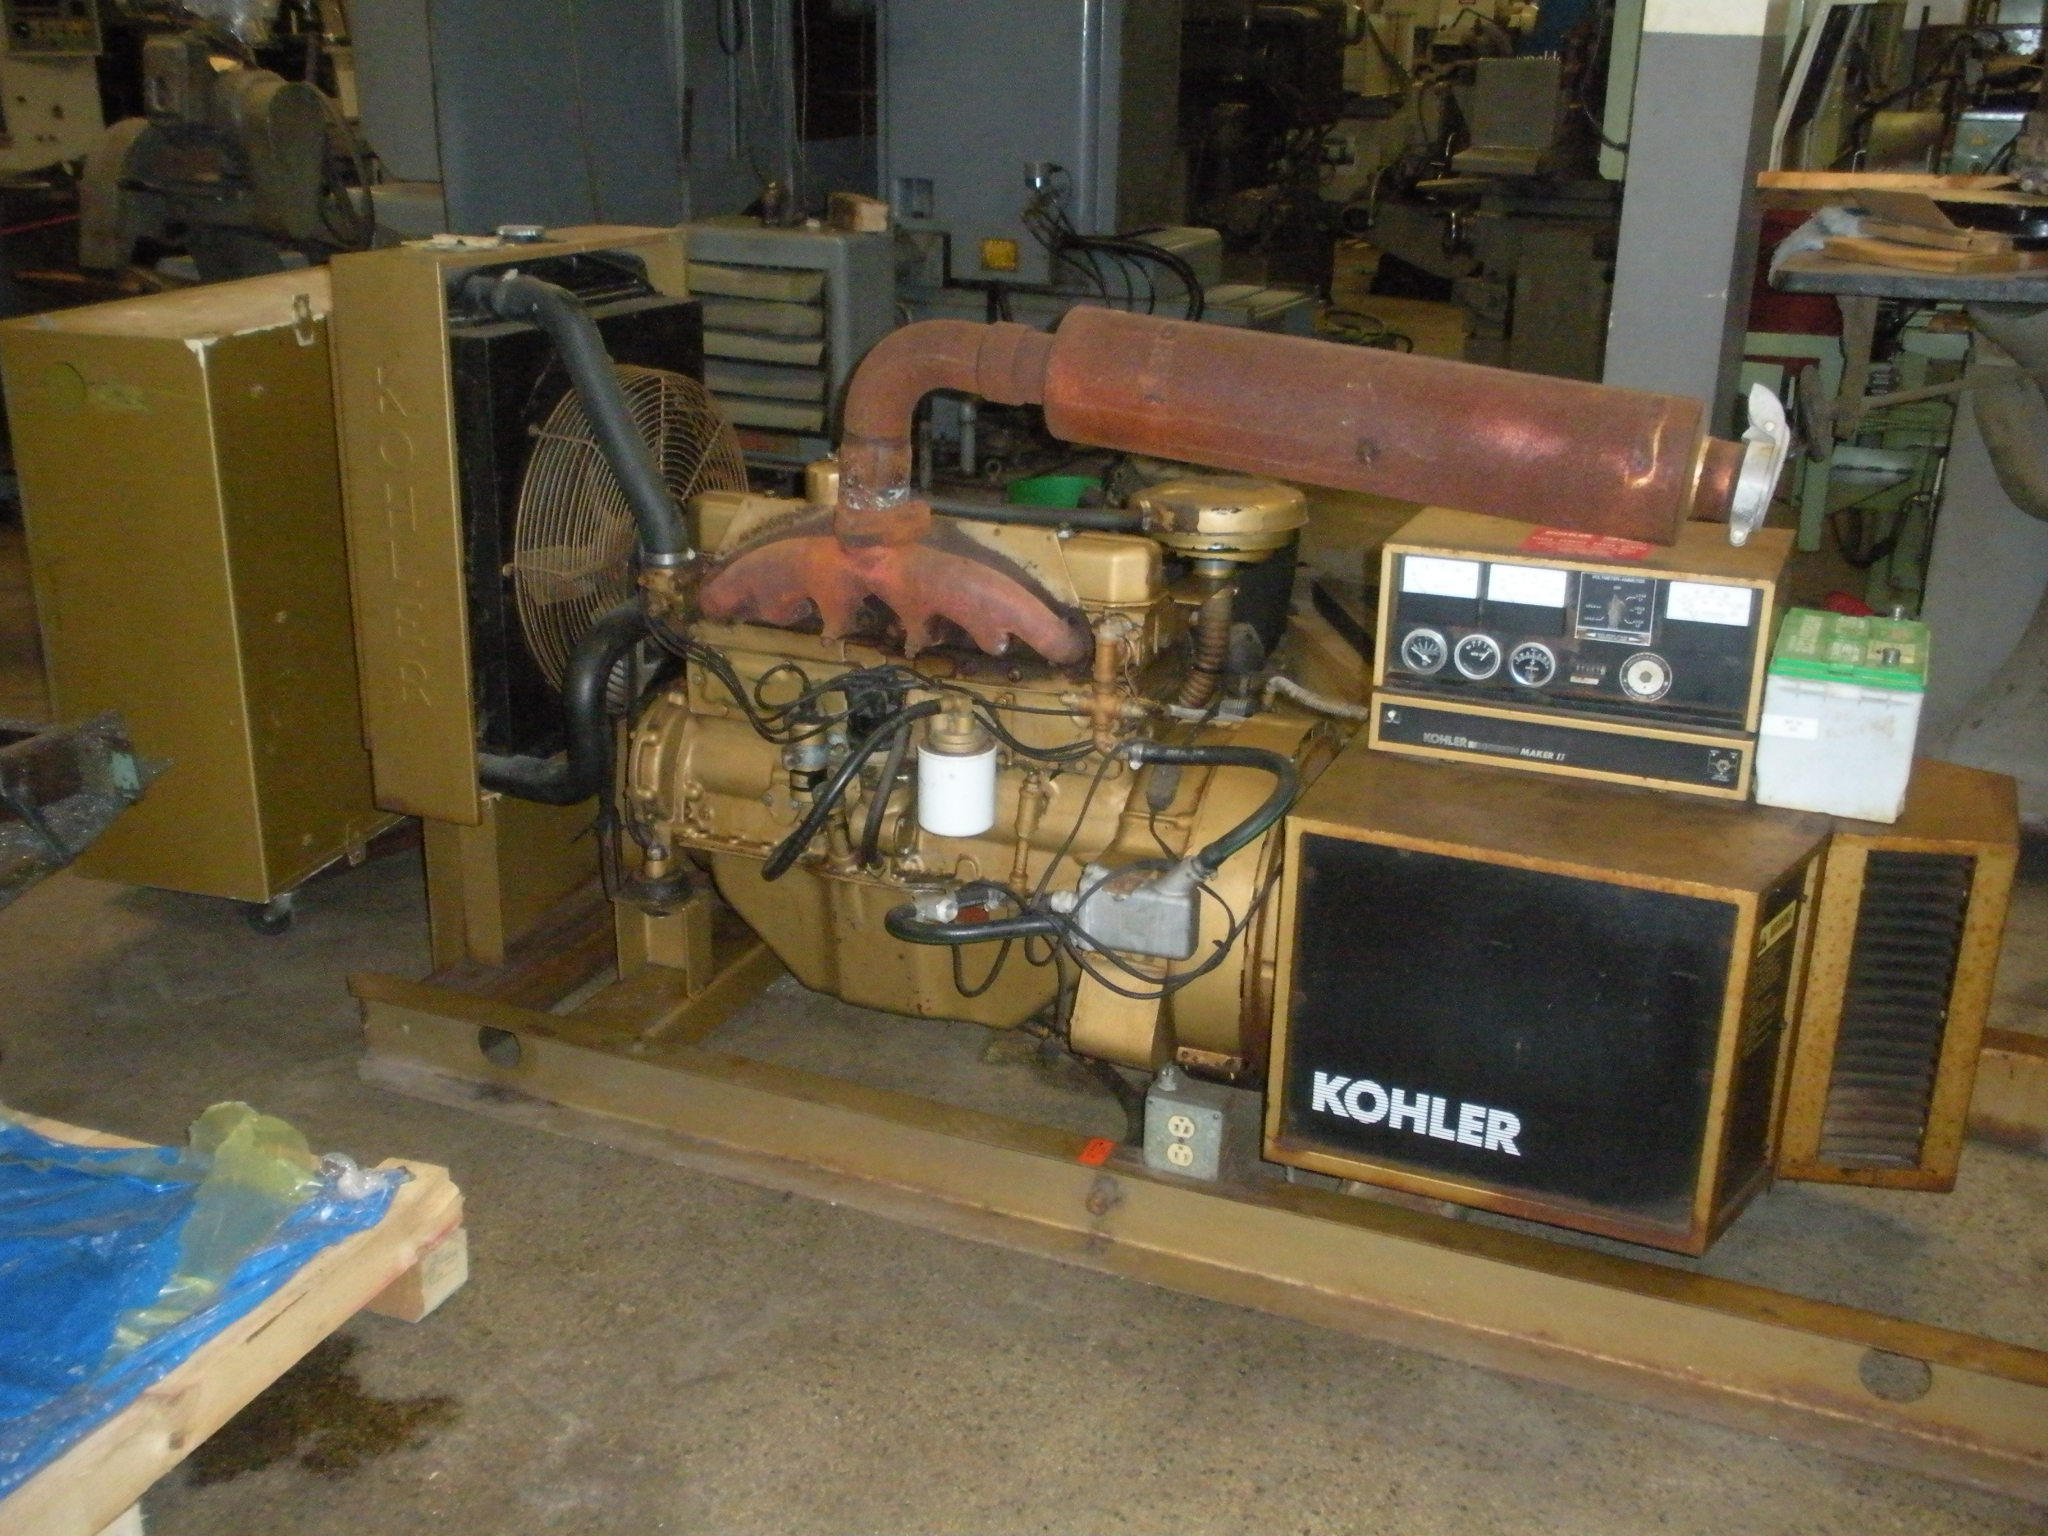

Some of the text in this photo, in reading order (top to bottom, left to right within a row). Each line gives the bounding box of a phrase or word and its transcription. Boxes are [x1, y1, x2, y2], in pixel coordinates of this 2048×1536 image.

[1423, 732, 1467, 748] KOHLER
[1520, 748, 1554, 760] MAKER
[1312, 1071, 1521, 1157] KOHLER
